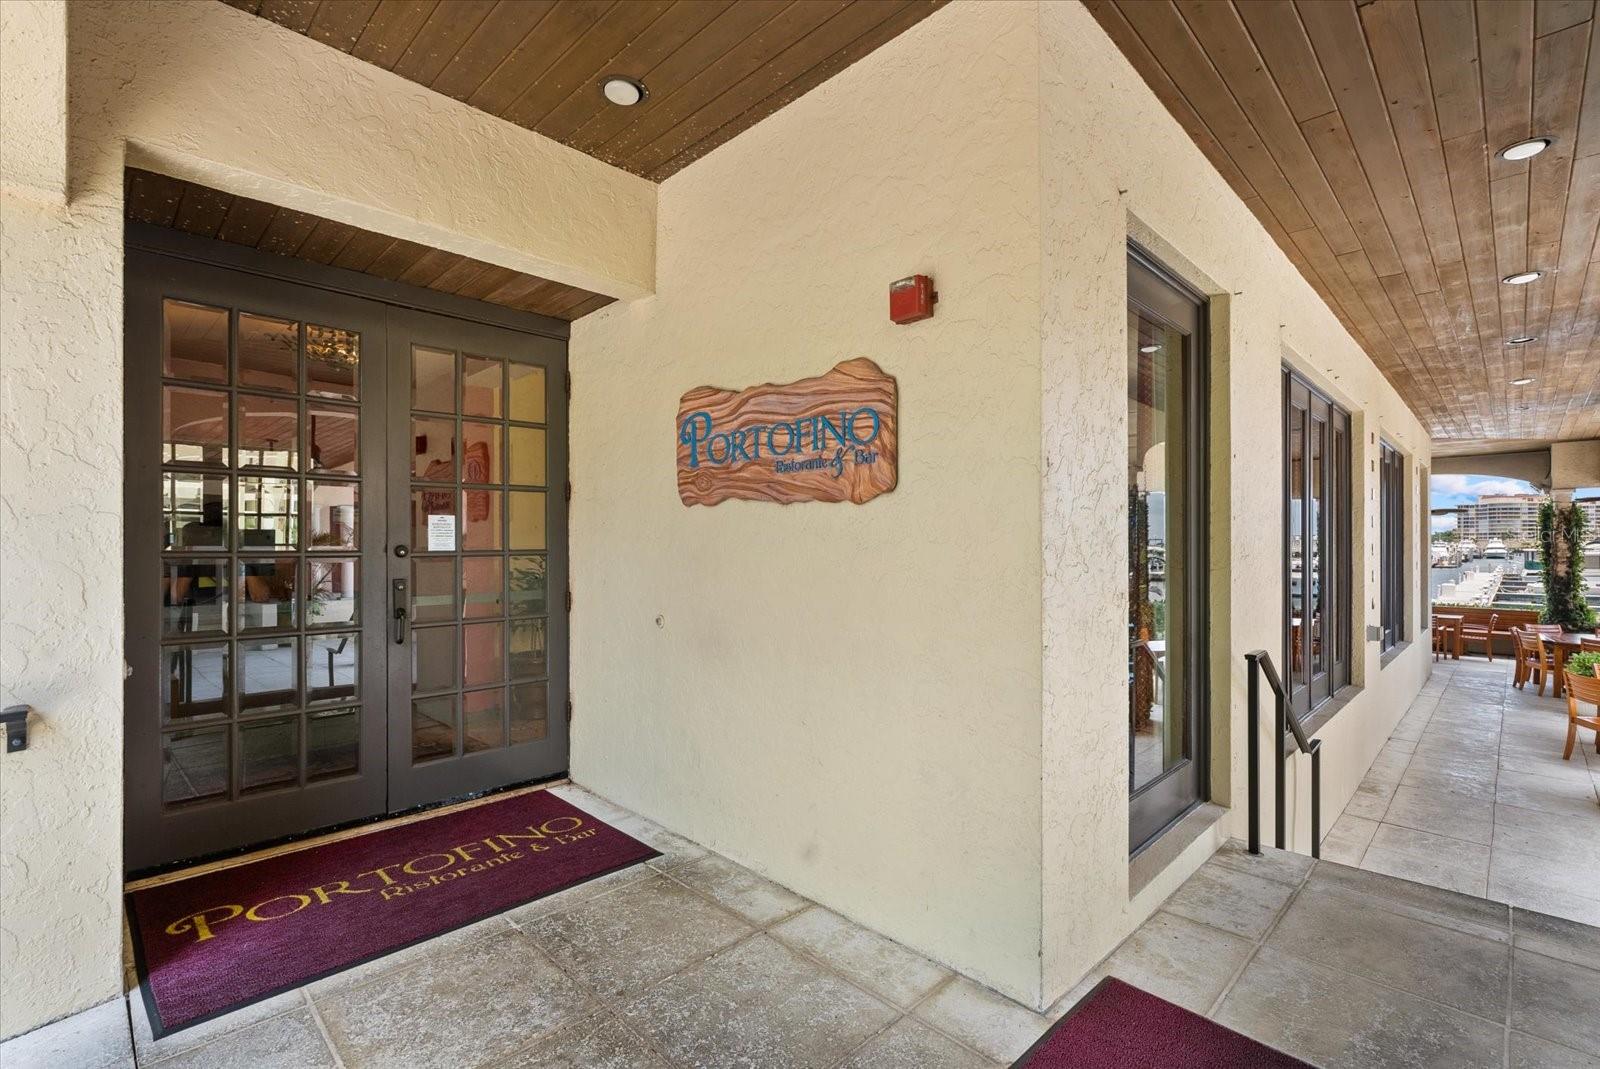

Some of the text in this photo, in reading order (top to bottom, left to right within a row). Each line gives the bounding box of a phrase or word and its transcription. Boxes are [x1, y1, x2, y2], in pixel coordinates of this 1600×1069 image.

[680, 407, 880, 468] PORTOFINO
[776, 444, 879, 479] Ristorante & Bar
[165, 815, 584, 943] PORTOFINO
[380, 827, 597, 901] Ristorante & Bar
